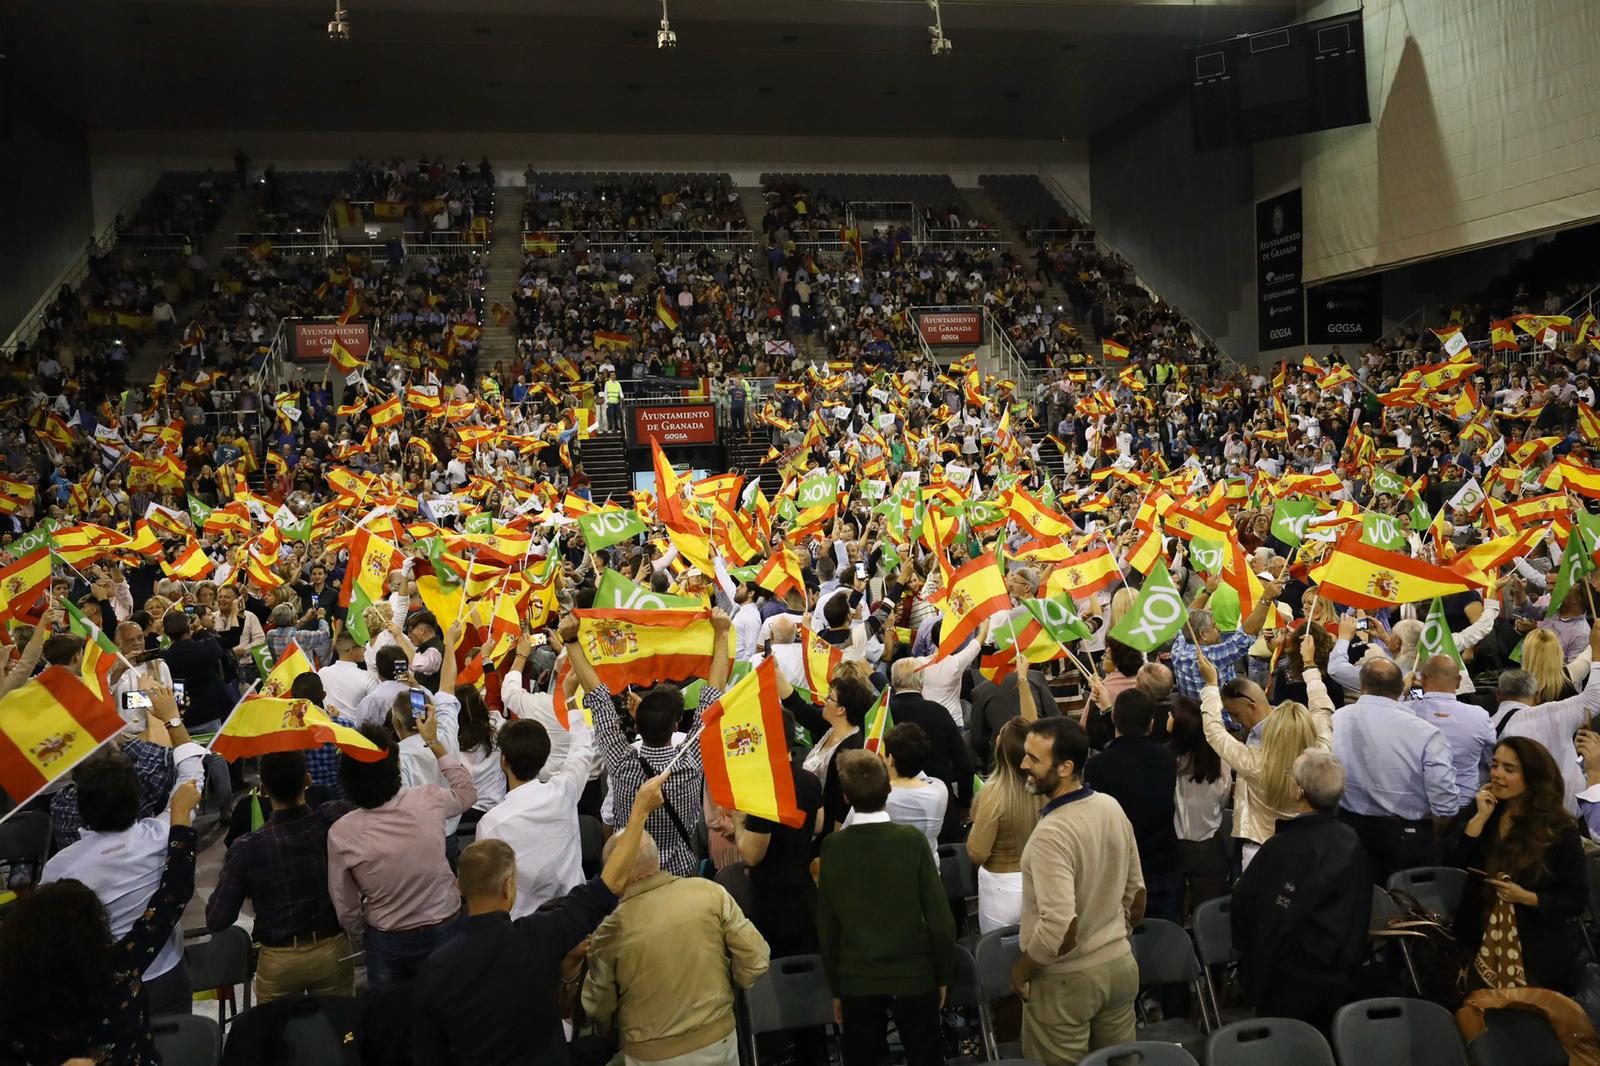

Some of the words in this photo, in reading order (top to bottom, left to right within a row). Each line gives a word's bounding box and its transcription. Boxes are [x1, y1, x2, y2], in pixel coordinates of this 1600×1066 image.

[923, 316, 976, 324] AYUNTAMIENTO
[938, 324, 972, 332] GRANADA
[320, 336, 360, 346] GRADA
[641, 410, 710, 420] AYUNTAMIENTO
[661, 420, 705, 431] GRANADA
[433, 503, 455, 513] VOX
[590, 509, 637, 537] VOX
[1368, 516, 1400, 544] VOX
